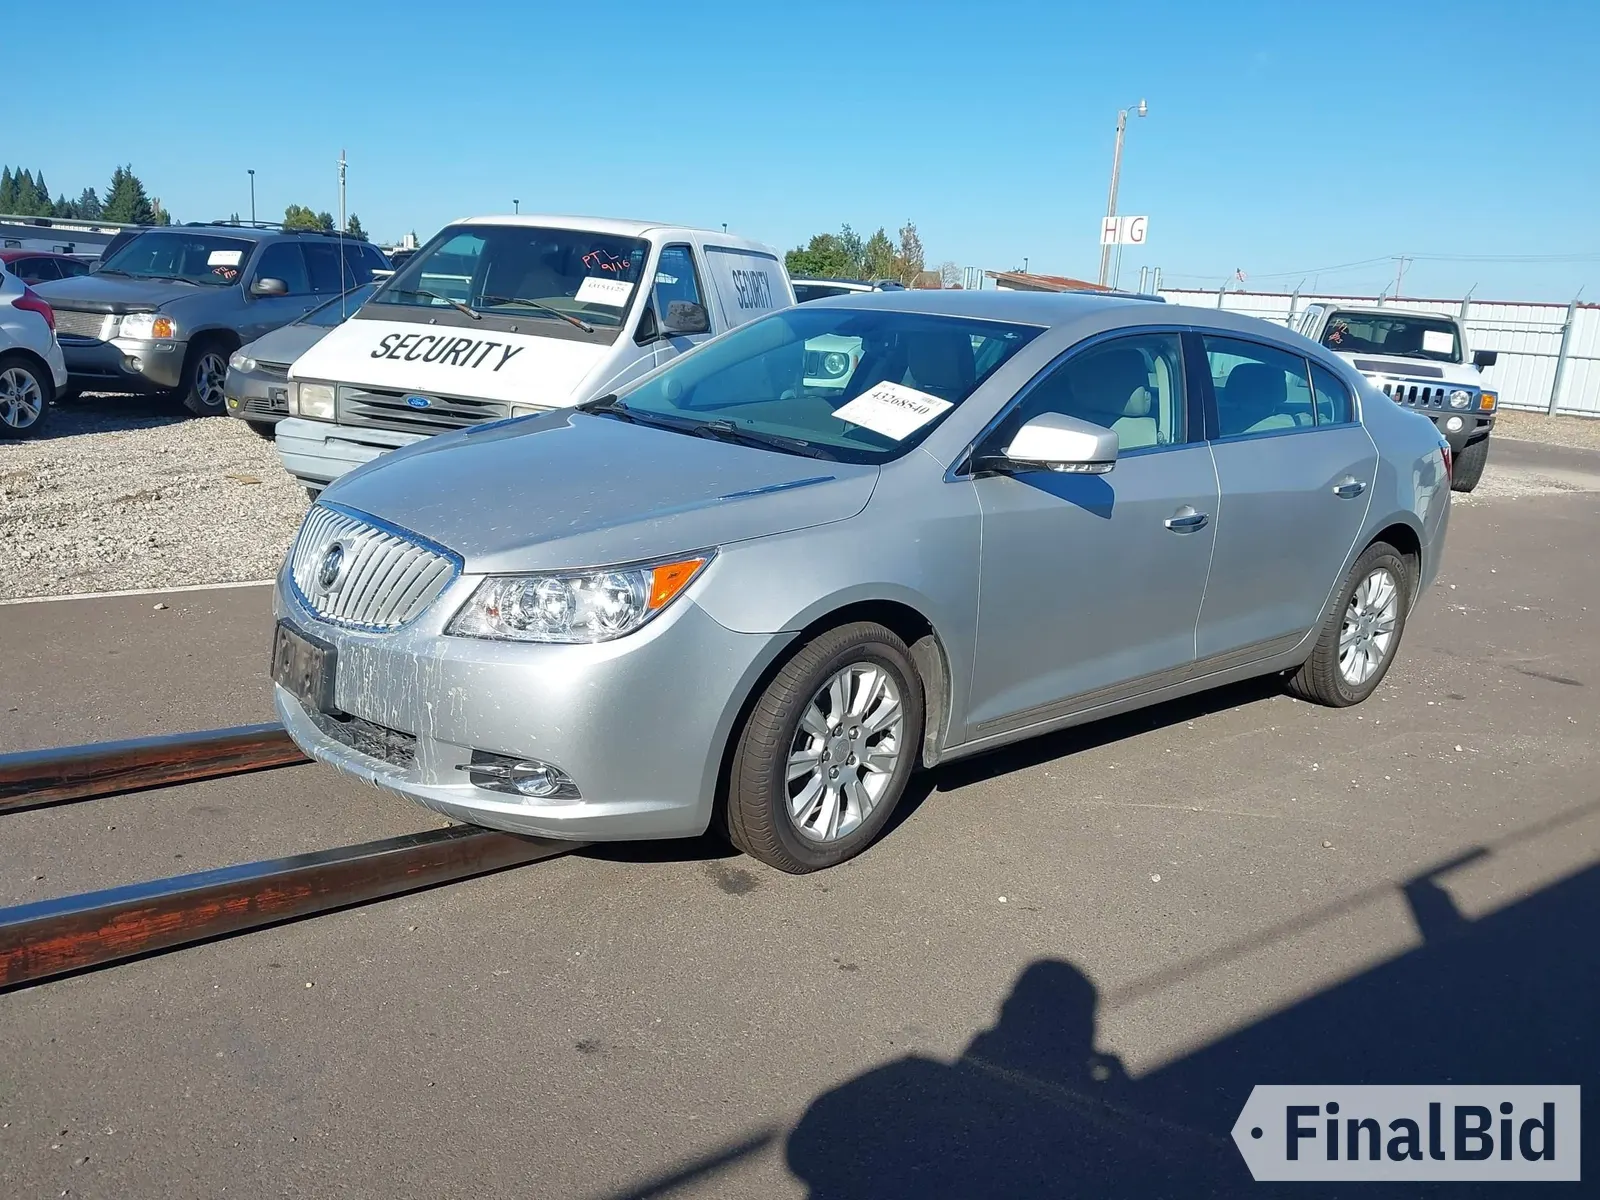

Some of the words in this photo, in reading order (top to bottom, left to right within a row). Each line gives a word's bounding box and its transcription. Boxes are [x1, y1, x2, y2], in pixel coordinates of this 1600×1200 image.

[1103, 218, 1118, 243] H
[1130, 217, 1144, 242] G
[732, 269, 774, 310] SECURITY
[370, 333, 525, 373] SECURITY
[871, 390, 931, 416] 43268540
